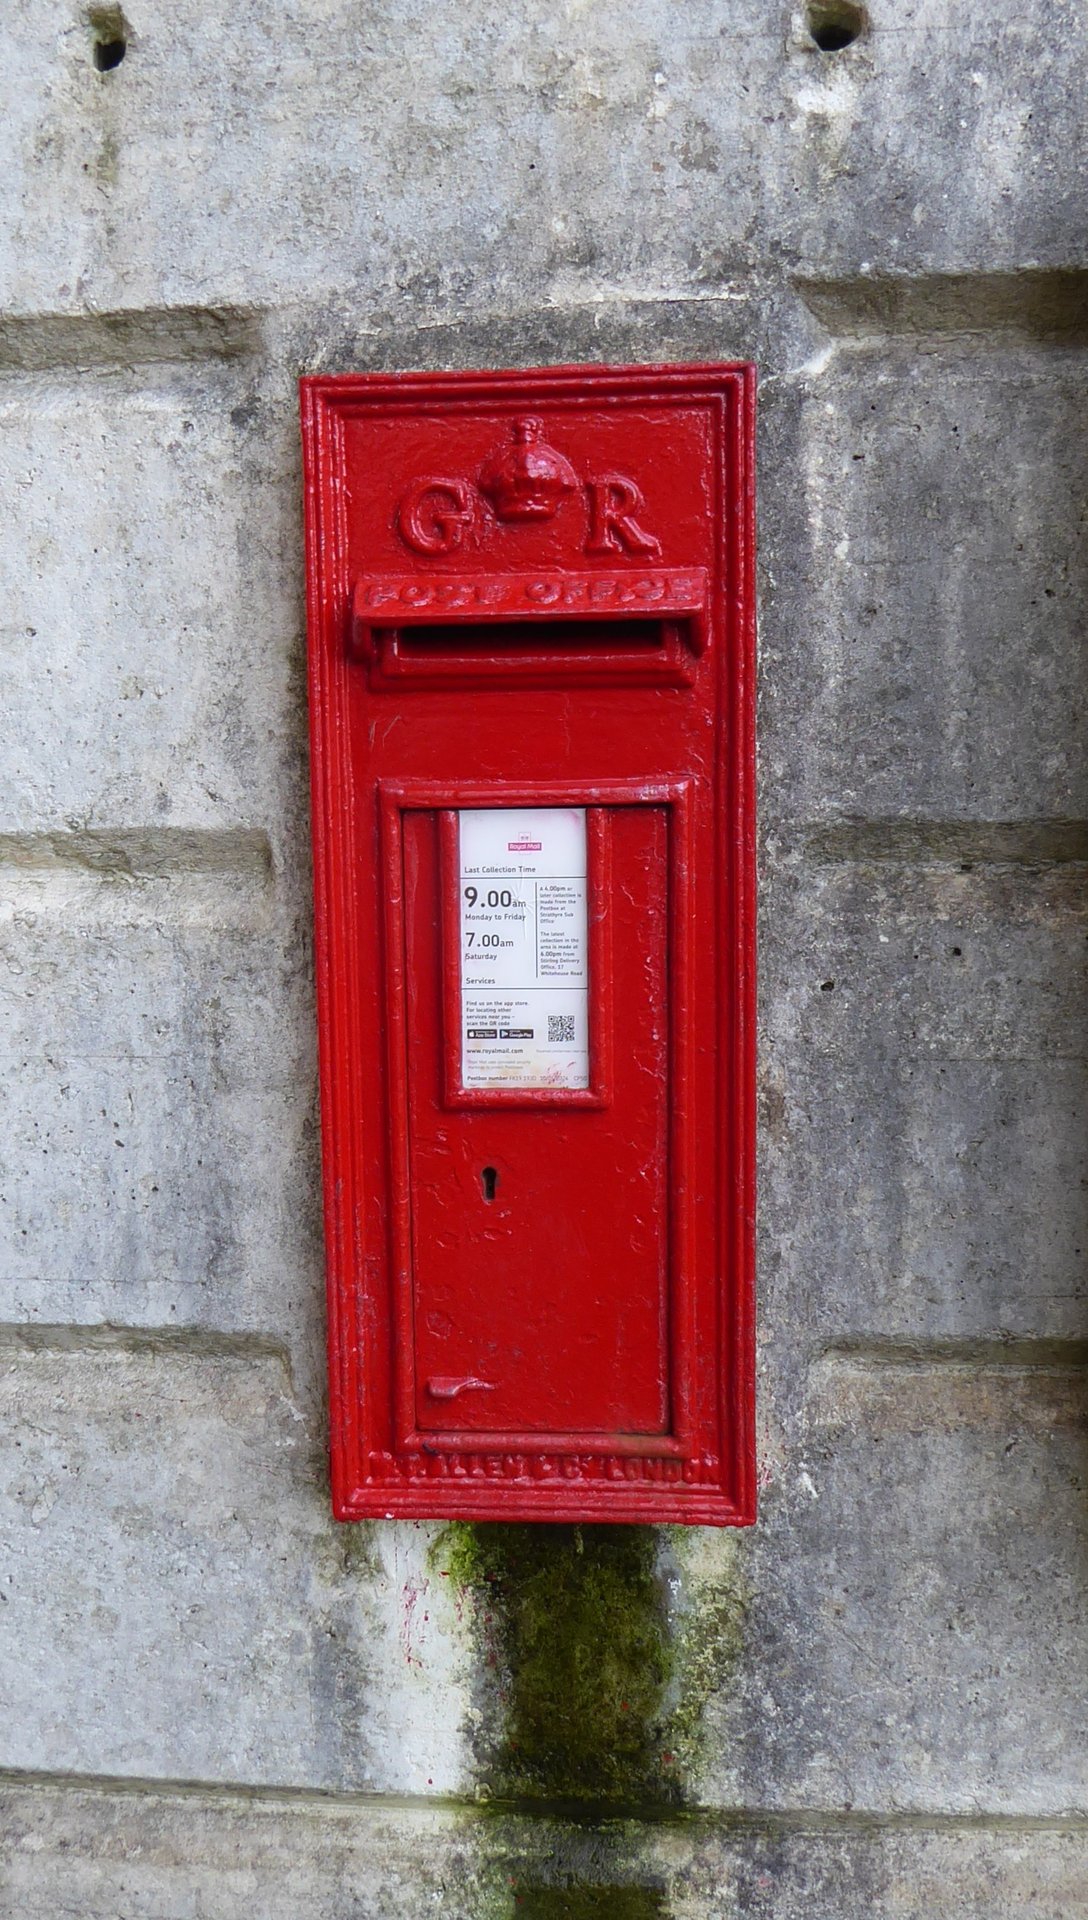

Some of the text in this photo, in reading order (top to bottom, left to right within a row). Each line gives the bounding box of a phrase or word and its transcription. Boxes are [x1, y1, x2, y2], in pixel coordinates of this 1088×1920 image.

[400, 473, 663, 556] G R
[365, 575, 693, 607] POST OFFICE
[509, 843, 526, 851] Royal
[464, 865, 537, 874] Last Collection Time
[464, 886, 527, 908] 9.00am
[465, 914, 493, 922] Monday
[504, 913, 526, 922] Friday
[465, 932, 514, 948] 7.00am
[465, 953, 497, 961] Saturday
[466, 977, 496, 985] Services
